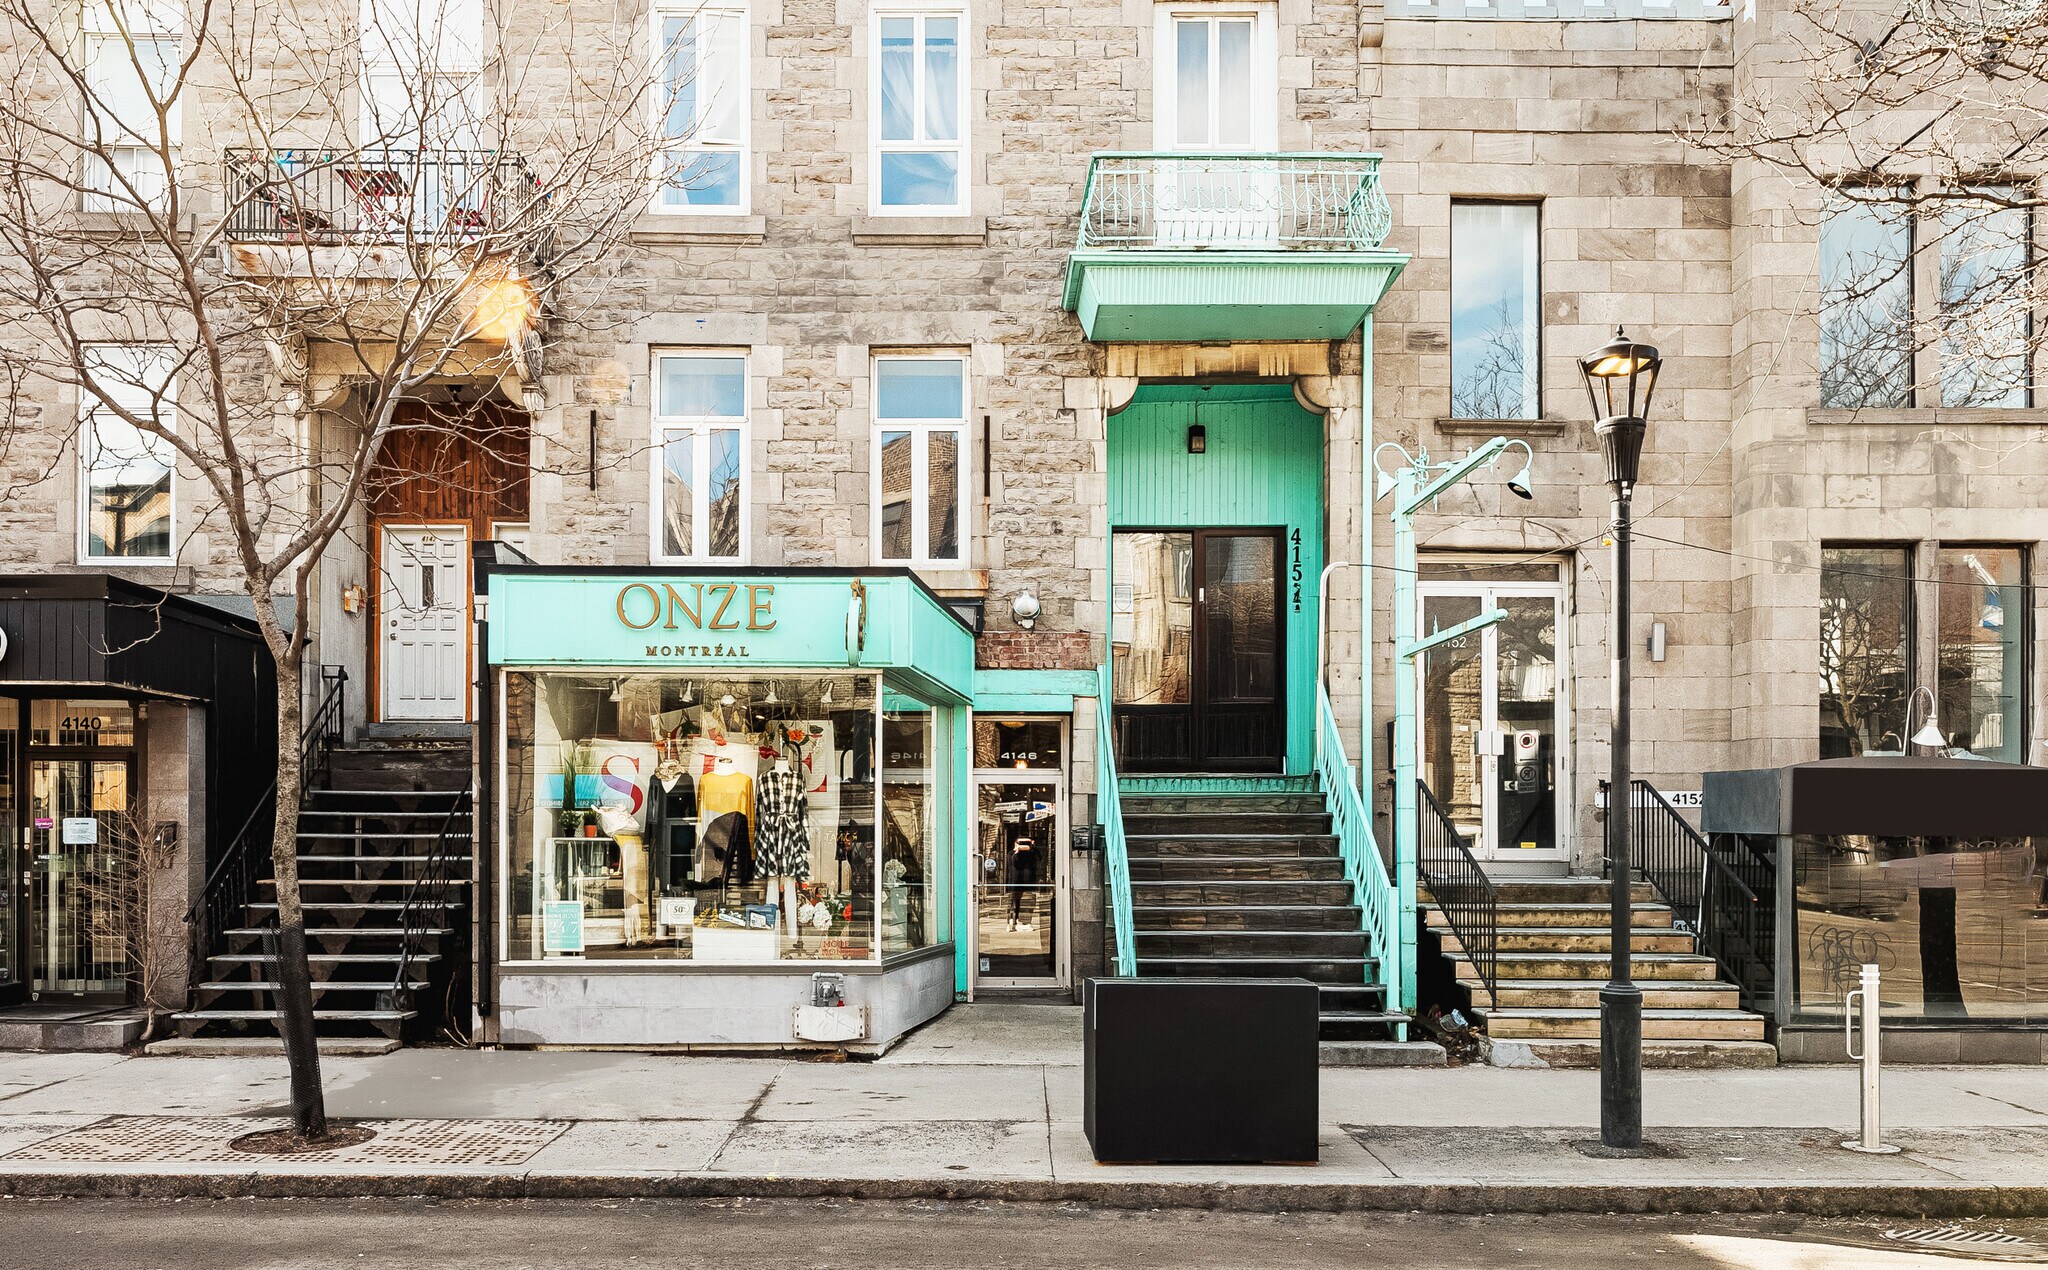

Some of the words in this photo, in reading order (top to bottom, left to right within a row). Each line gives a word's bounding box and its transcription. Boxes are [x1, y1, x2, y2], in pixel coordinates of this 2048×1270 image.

[616, 583, 777, 629] ONZE
[645, 643, 750, 656] MONTRÉAL
[62, 717, 101, 729] 4140
[1001, 752, 1037, 760] 4146
